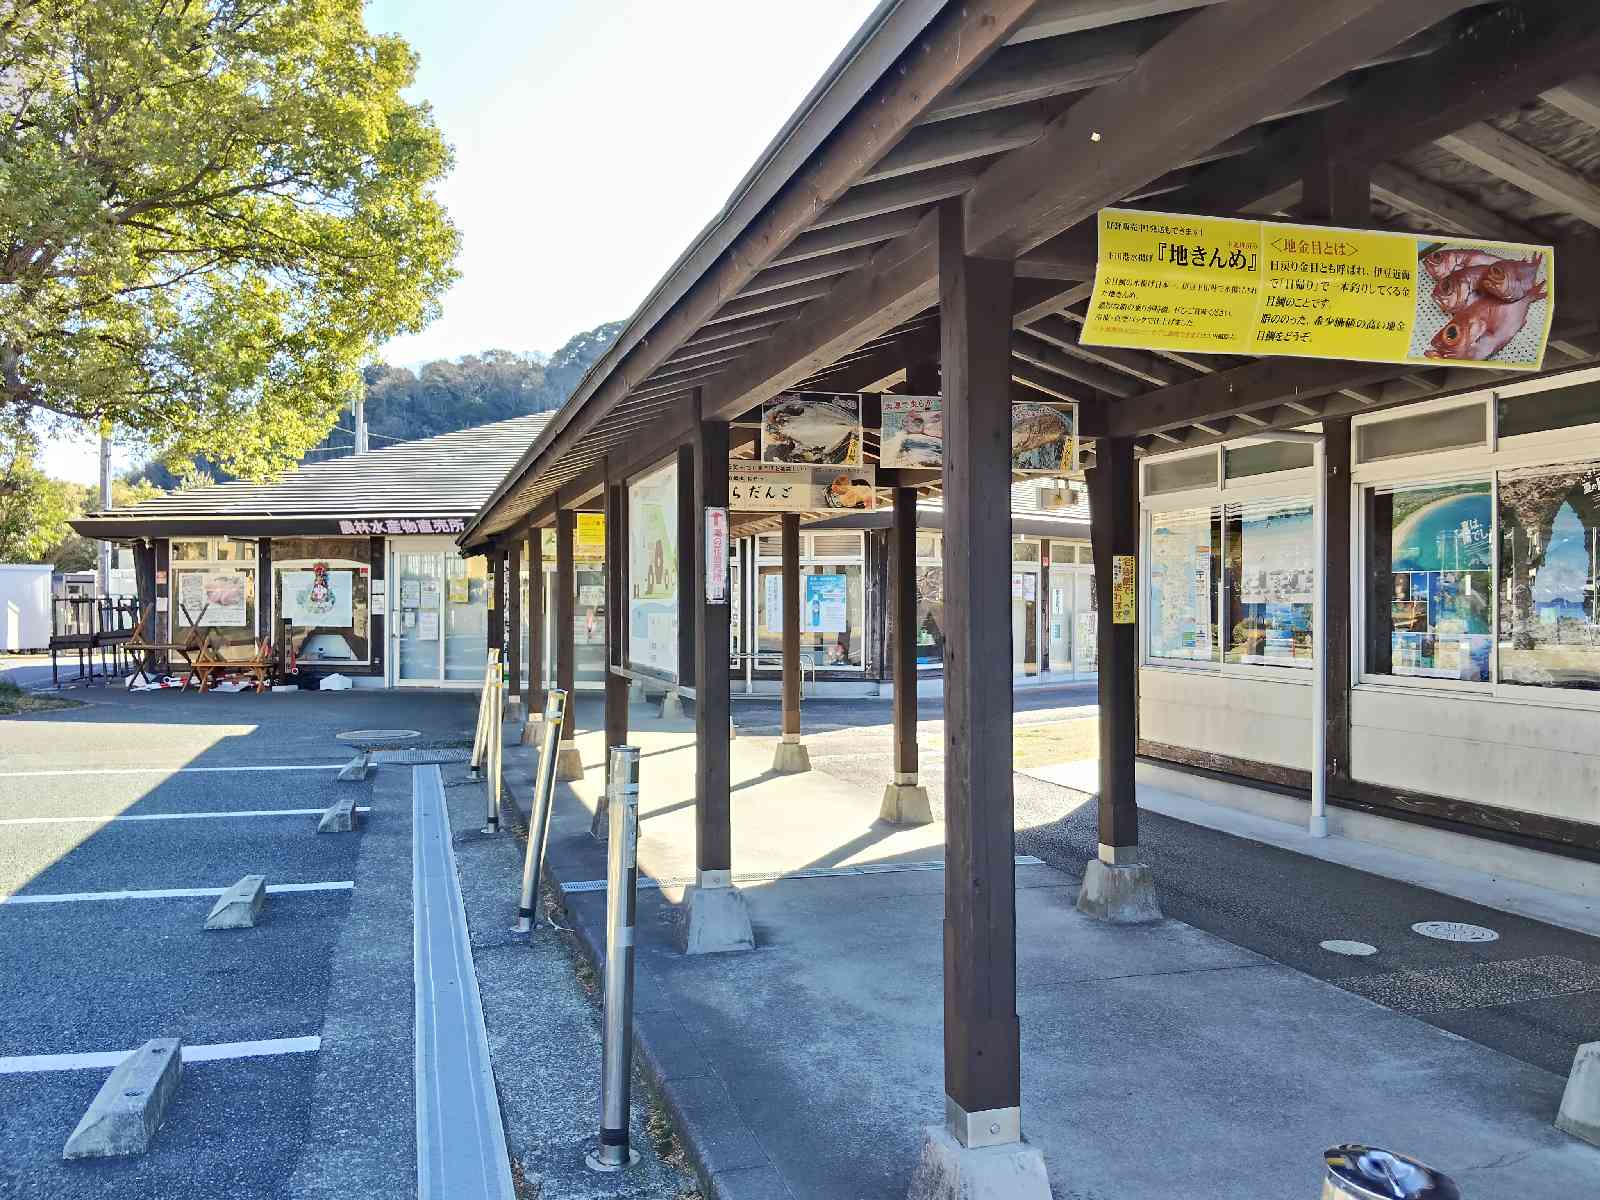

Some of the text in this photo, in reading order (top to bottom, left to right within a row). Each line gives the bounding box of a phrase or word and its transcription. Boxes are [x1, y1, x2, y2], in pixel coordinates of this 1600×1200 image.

[1158, 242, 1257, 272] 『地きんめ』
[338, 518, 465, 534] 農林水産物直売所
